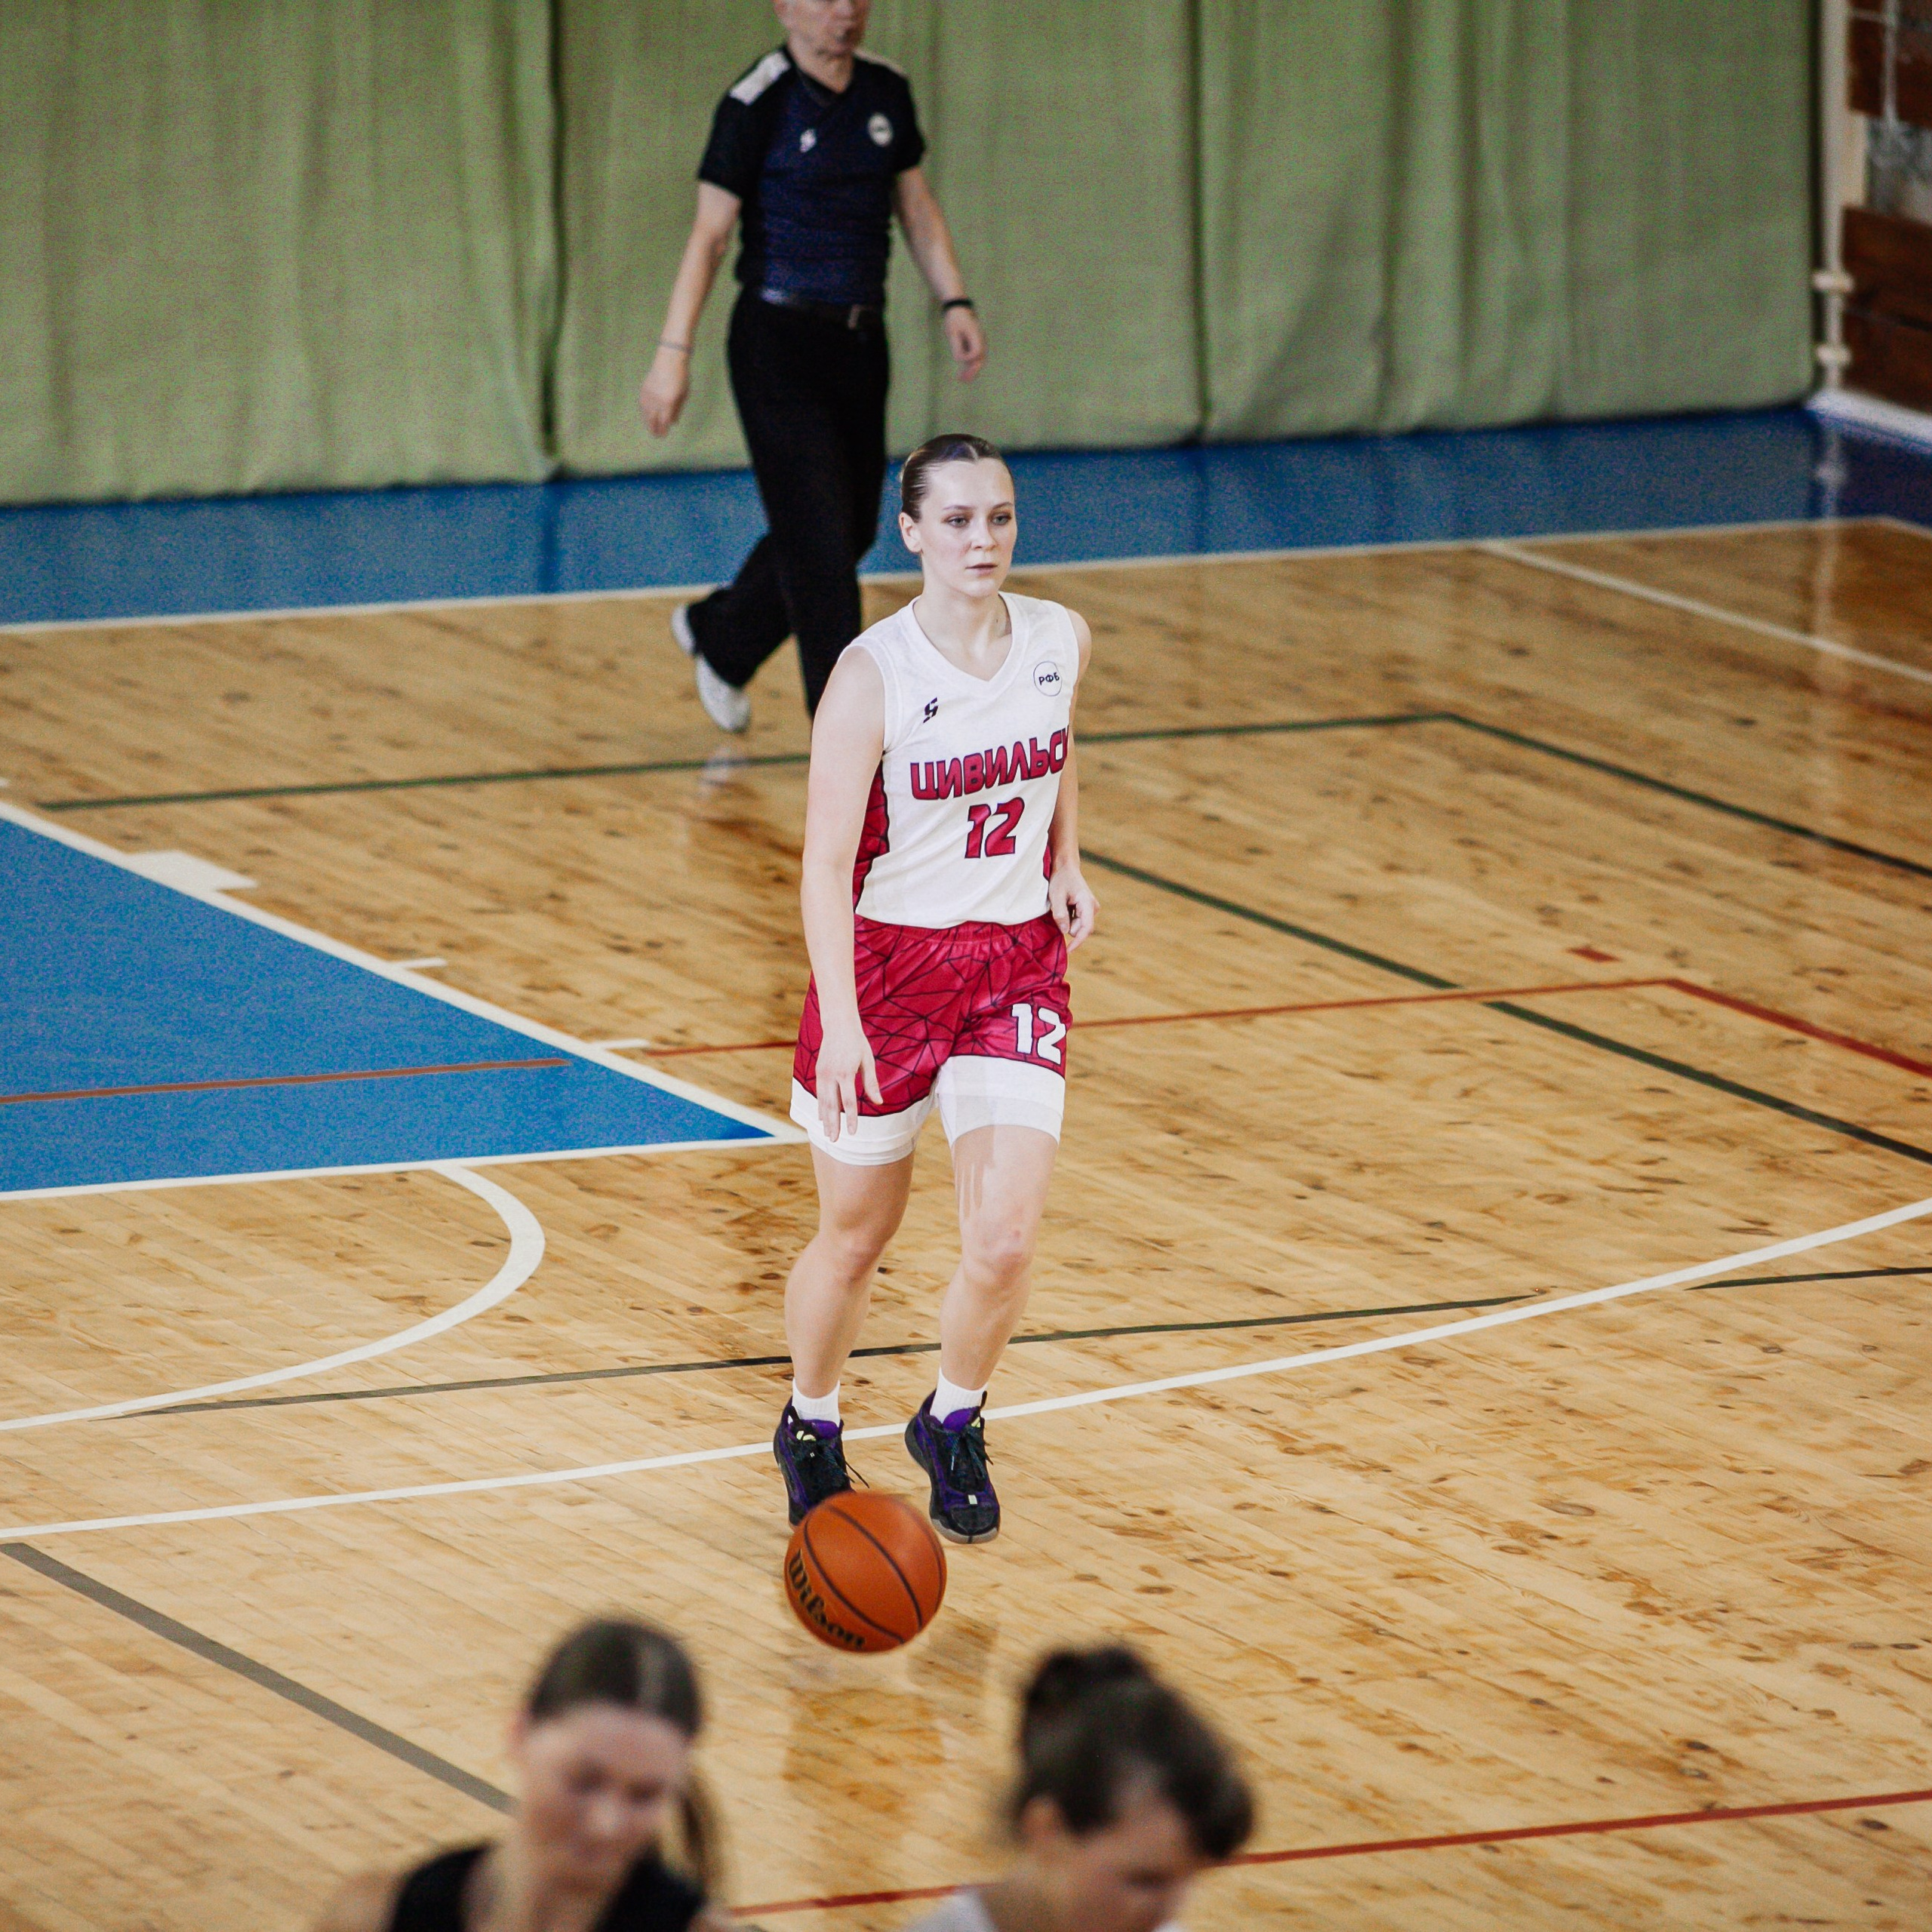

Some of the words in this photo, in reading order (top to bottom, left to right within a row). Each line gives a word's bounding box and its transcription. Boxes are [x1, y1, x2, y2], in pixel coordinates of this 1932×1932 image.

[1038, 672, 1060, 685] РФБ
[964, 797, 1025, 859] 12
[1011, 1002, 1066, 1066] 12
